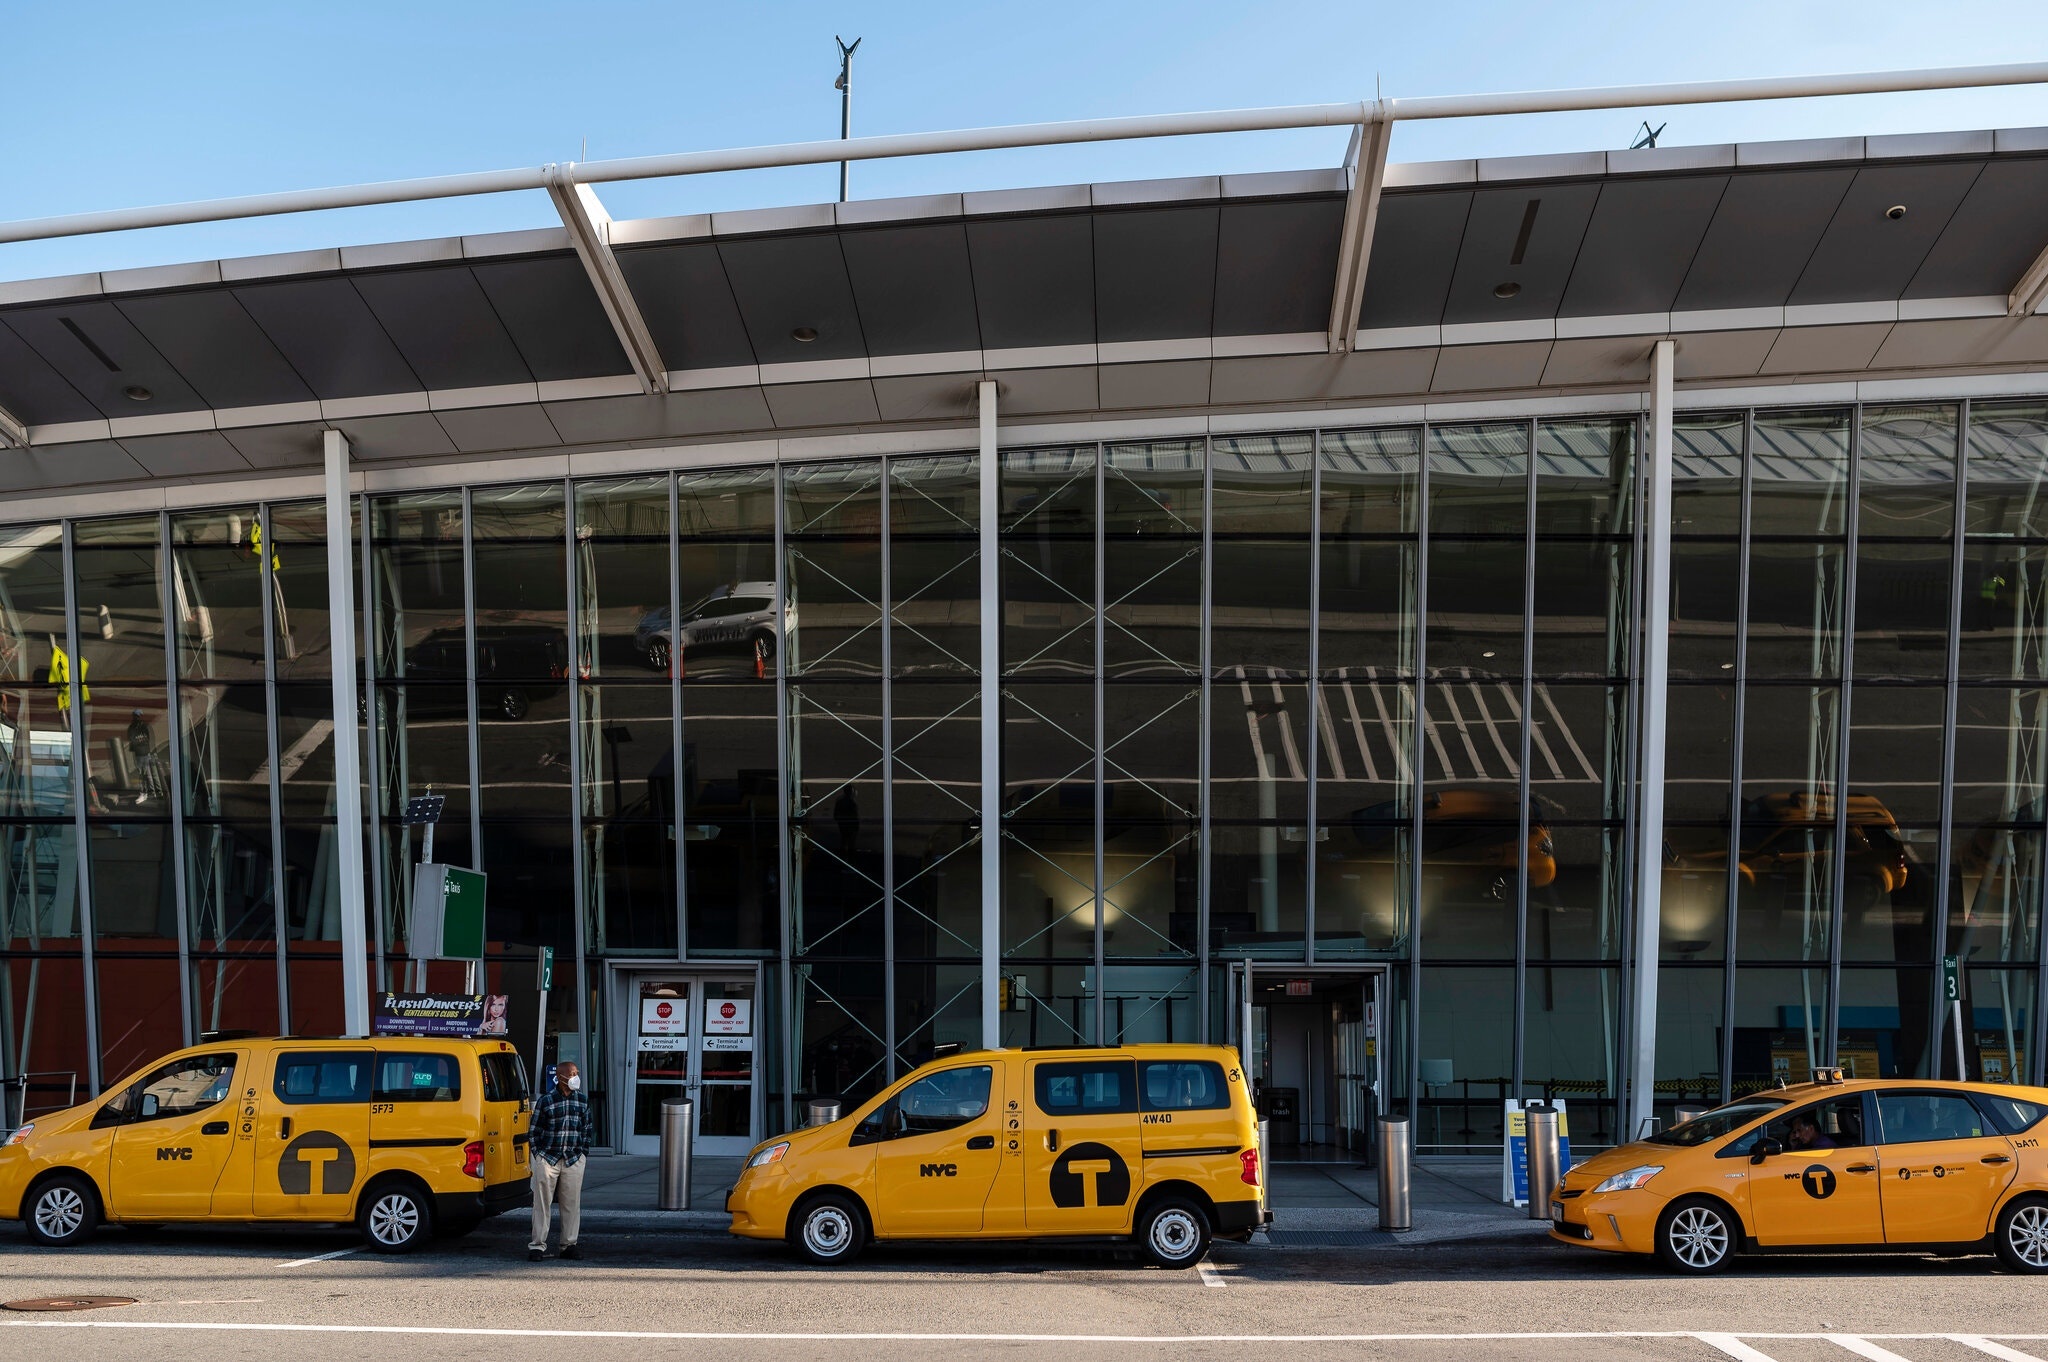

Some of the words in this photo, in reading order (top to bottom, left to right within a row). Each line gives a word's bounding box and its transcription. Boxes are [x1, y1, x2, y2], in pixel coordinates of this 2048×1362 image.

[450, 881, 461, 894] Taxis
[1945, 959, 1957, 968] Taxi
[544, 967, 551, 988] 2
[1948, 976, 1956, 998] 3
[403, 1009, 440, 1018] GENTLEMEN'S
[440, 1010, 460, 1018] CLUBS
[1142, 1113, 1172, 1125] 4W40
[156, 1147, 192, 1161] NYC
[297, 1147, 339, 1195] T
[920, 1163, 957, 1177] NYC
[1067, 1159, 1111, 1207] T
[1809, 1171, 1831, 1195] T
